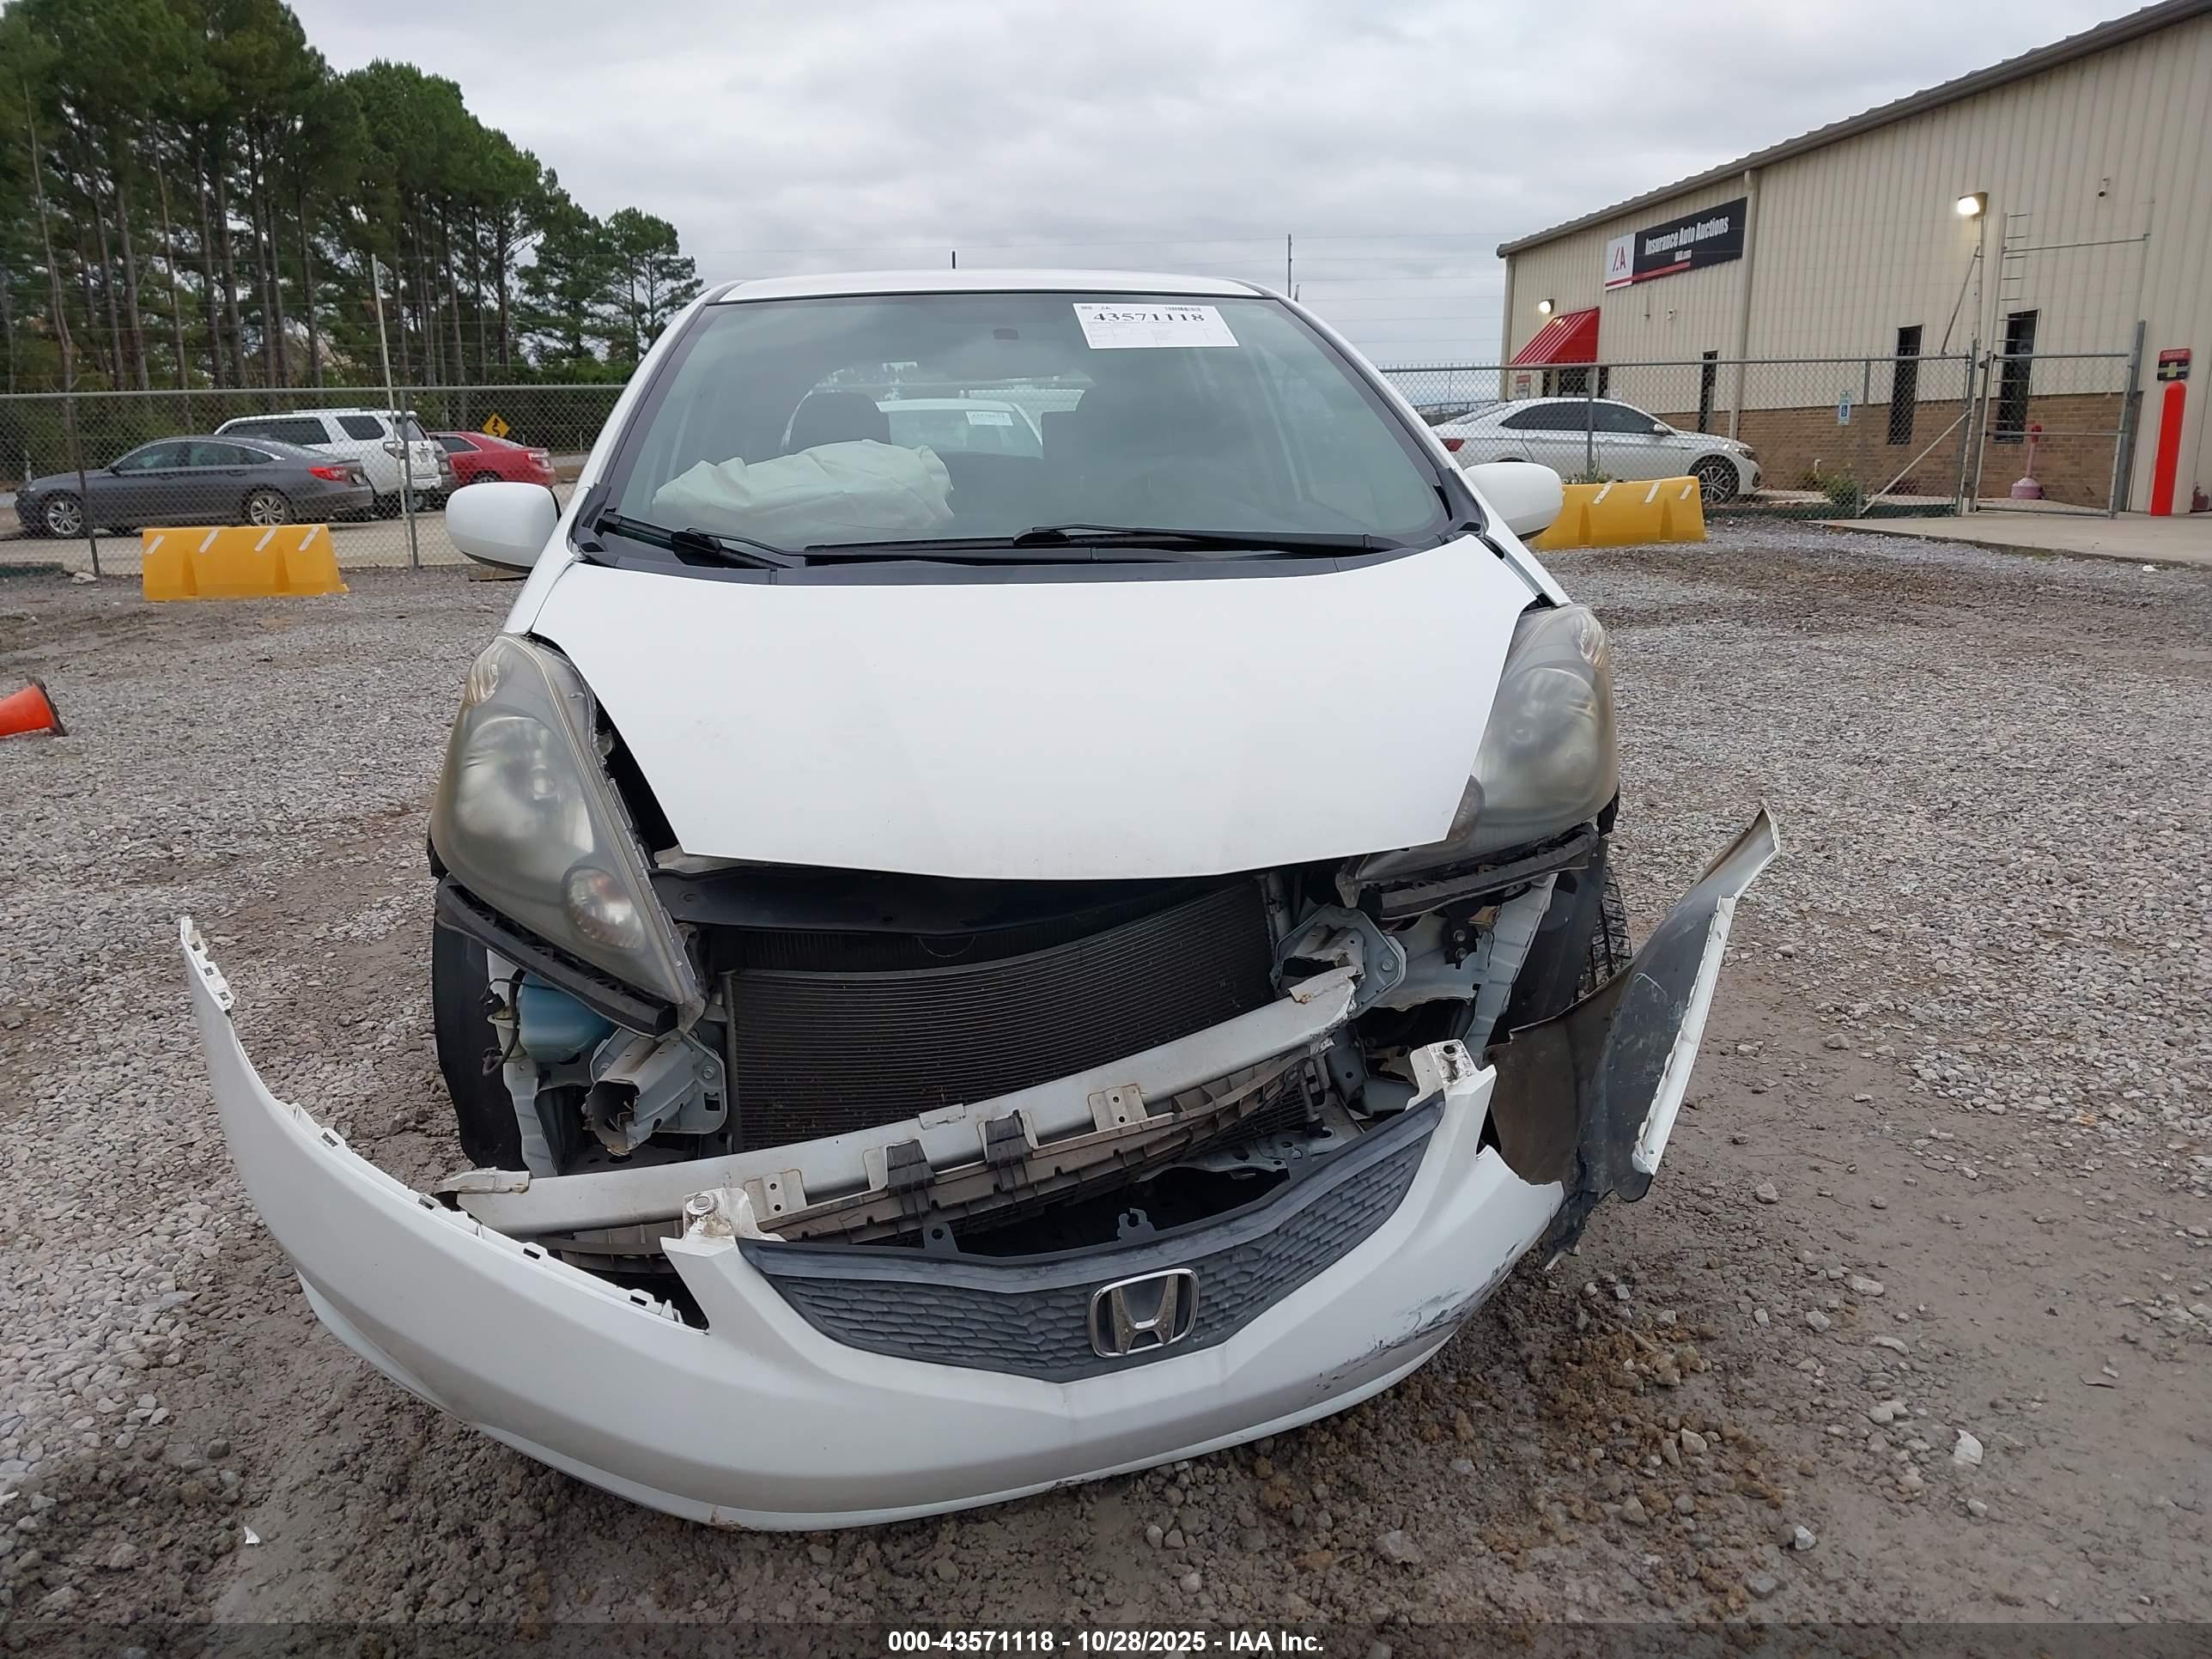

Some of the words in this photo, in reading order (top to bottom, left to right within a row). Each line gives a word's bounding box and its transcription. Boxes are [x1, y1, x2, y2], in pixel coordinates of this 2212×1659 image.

[1645, 232, 1678, 255] Insurance
[1679, 227, 1695, 246] Auto
[1696, 216, 1729, 241] Auctions
[1093, 313, 1205, 322] 43571118
